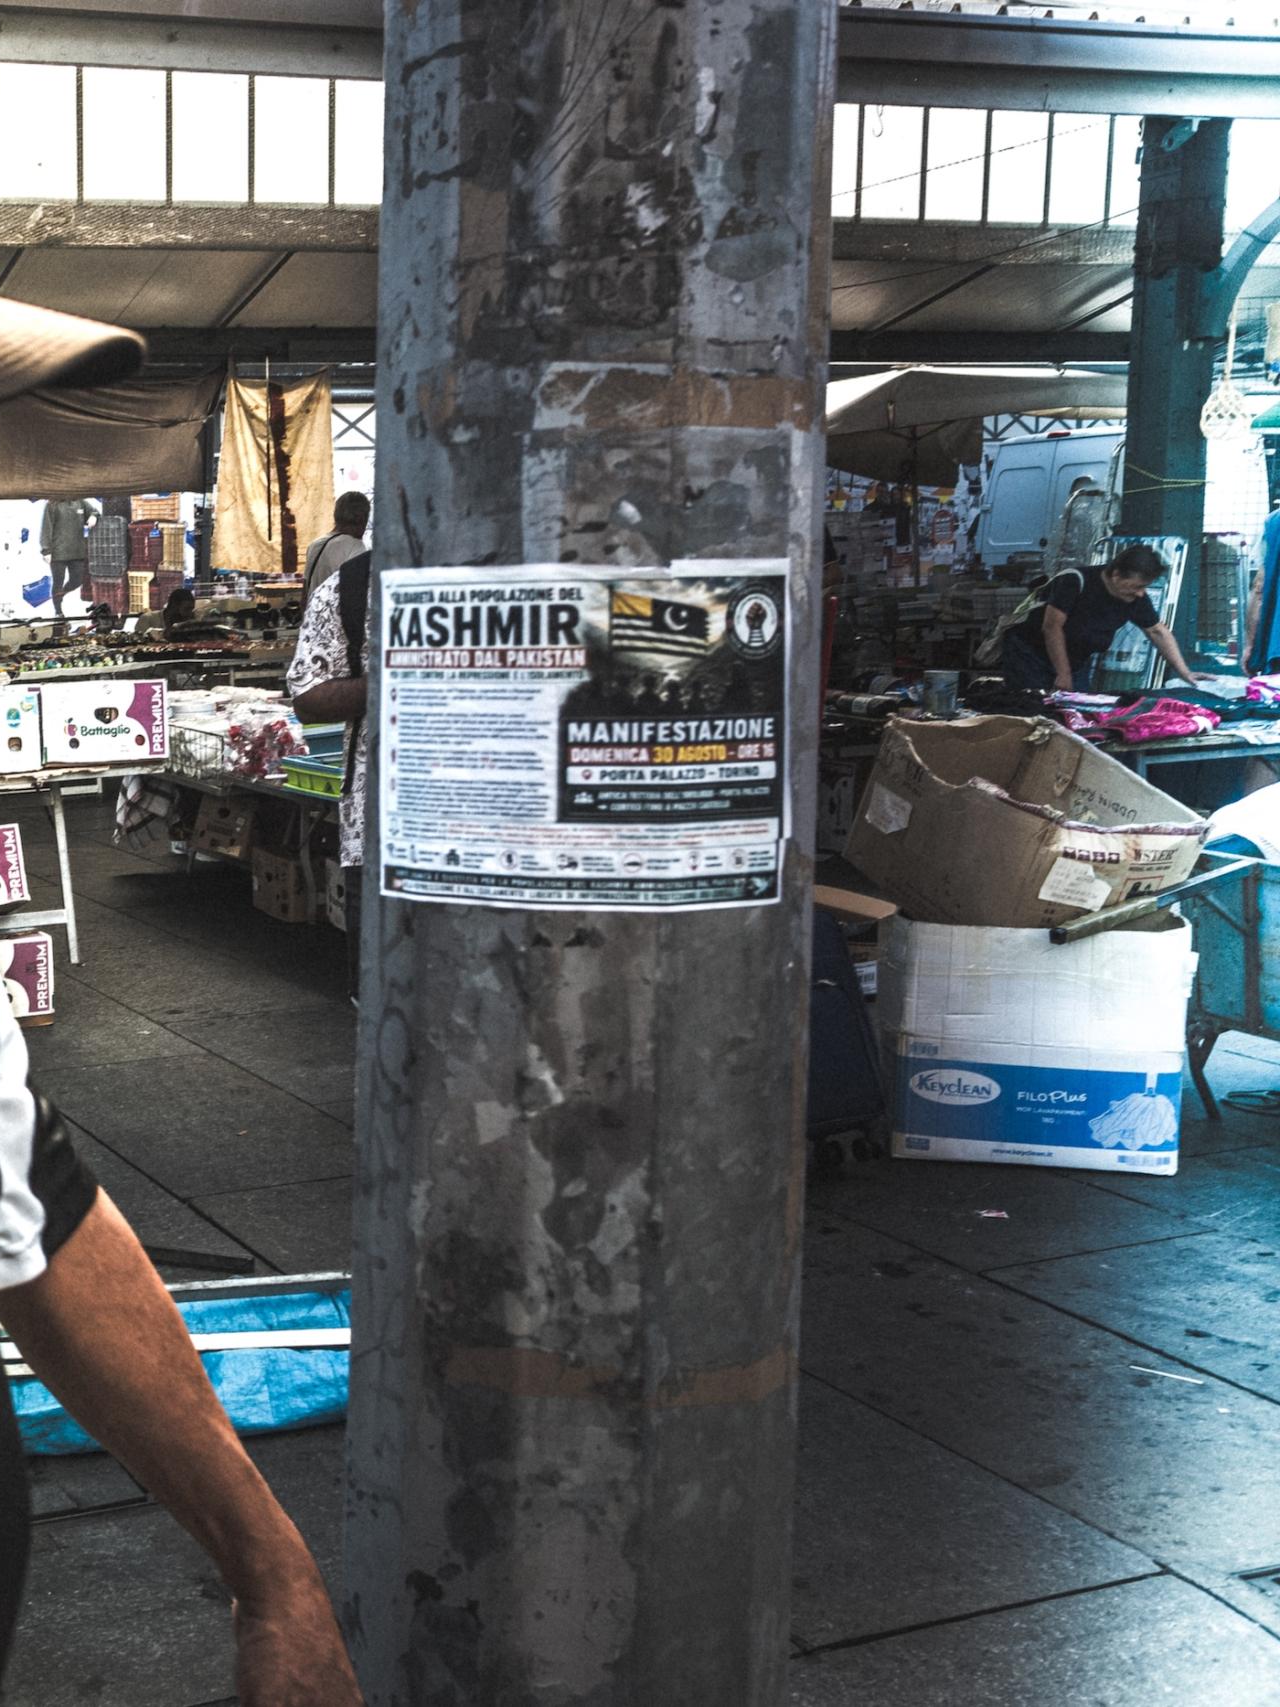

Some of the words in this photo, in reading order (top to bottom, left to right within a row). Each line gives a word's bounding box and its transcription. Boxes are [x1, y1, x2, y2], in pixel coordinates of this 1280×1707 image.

[439, 589, 466, 603] ALLA
[470, 588, 554, 602] POPOLAZIONE
[559, 587, 584, 601] DEL
[389, 604, 581, 647] KASHMIR
[474, 651, 502, 667] DAL
[506, 649, 586, 666] PAKISTAN
[150, 684, 163, 752] PREMIUM
[80, 724, 130, 738] Battaglio
[568, 718, 775, 742] MANIFESTAZIONE
[571, 747, 649, 763] DOMENICA
[653, 747, 673, 762] 30
[677, 745, 726, 762] AGOSTO
[737, 744, 759, 758] ORE
[599, 769, 645, 781] PORTA
[650, 768, 706, 780] PALAZZO
[718, 766, 759, 778] TORINO
[2, 830, 22, 899] PREMIUM
[37, 944, 48, 1010] PREMIUM
[1017, 1091, 1046, 1102] FILO
[1048, 1090, 1087, 1103] Plus
